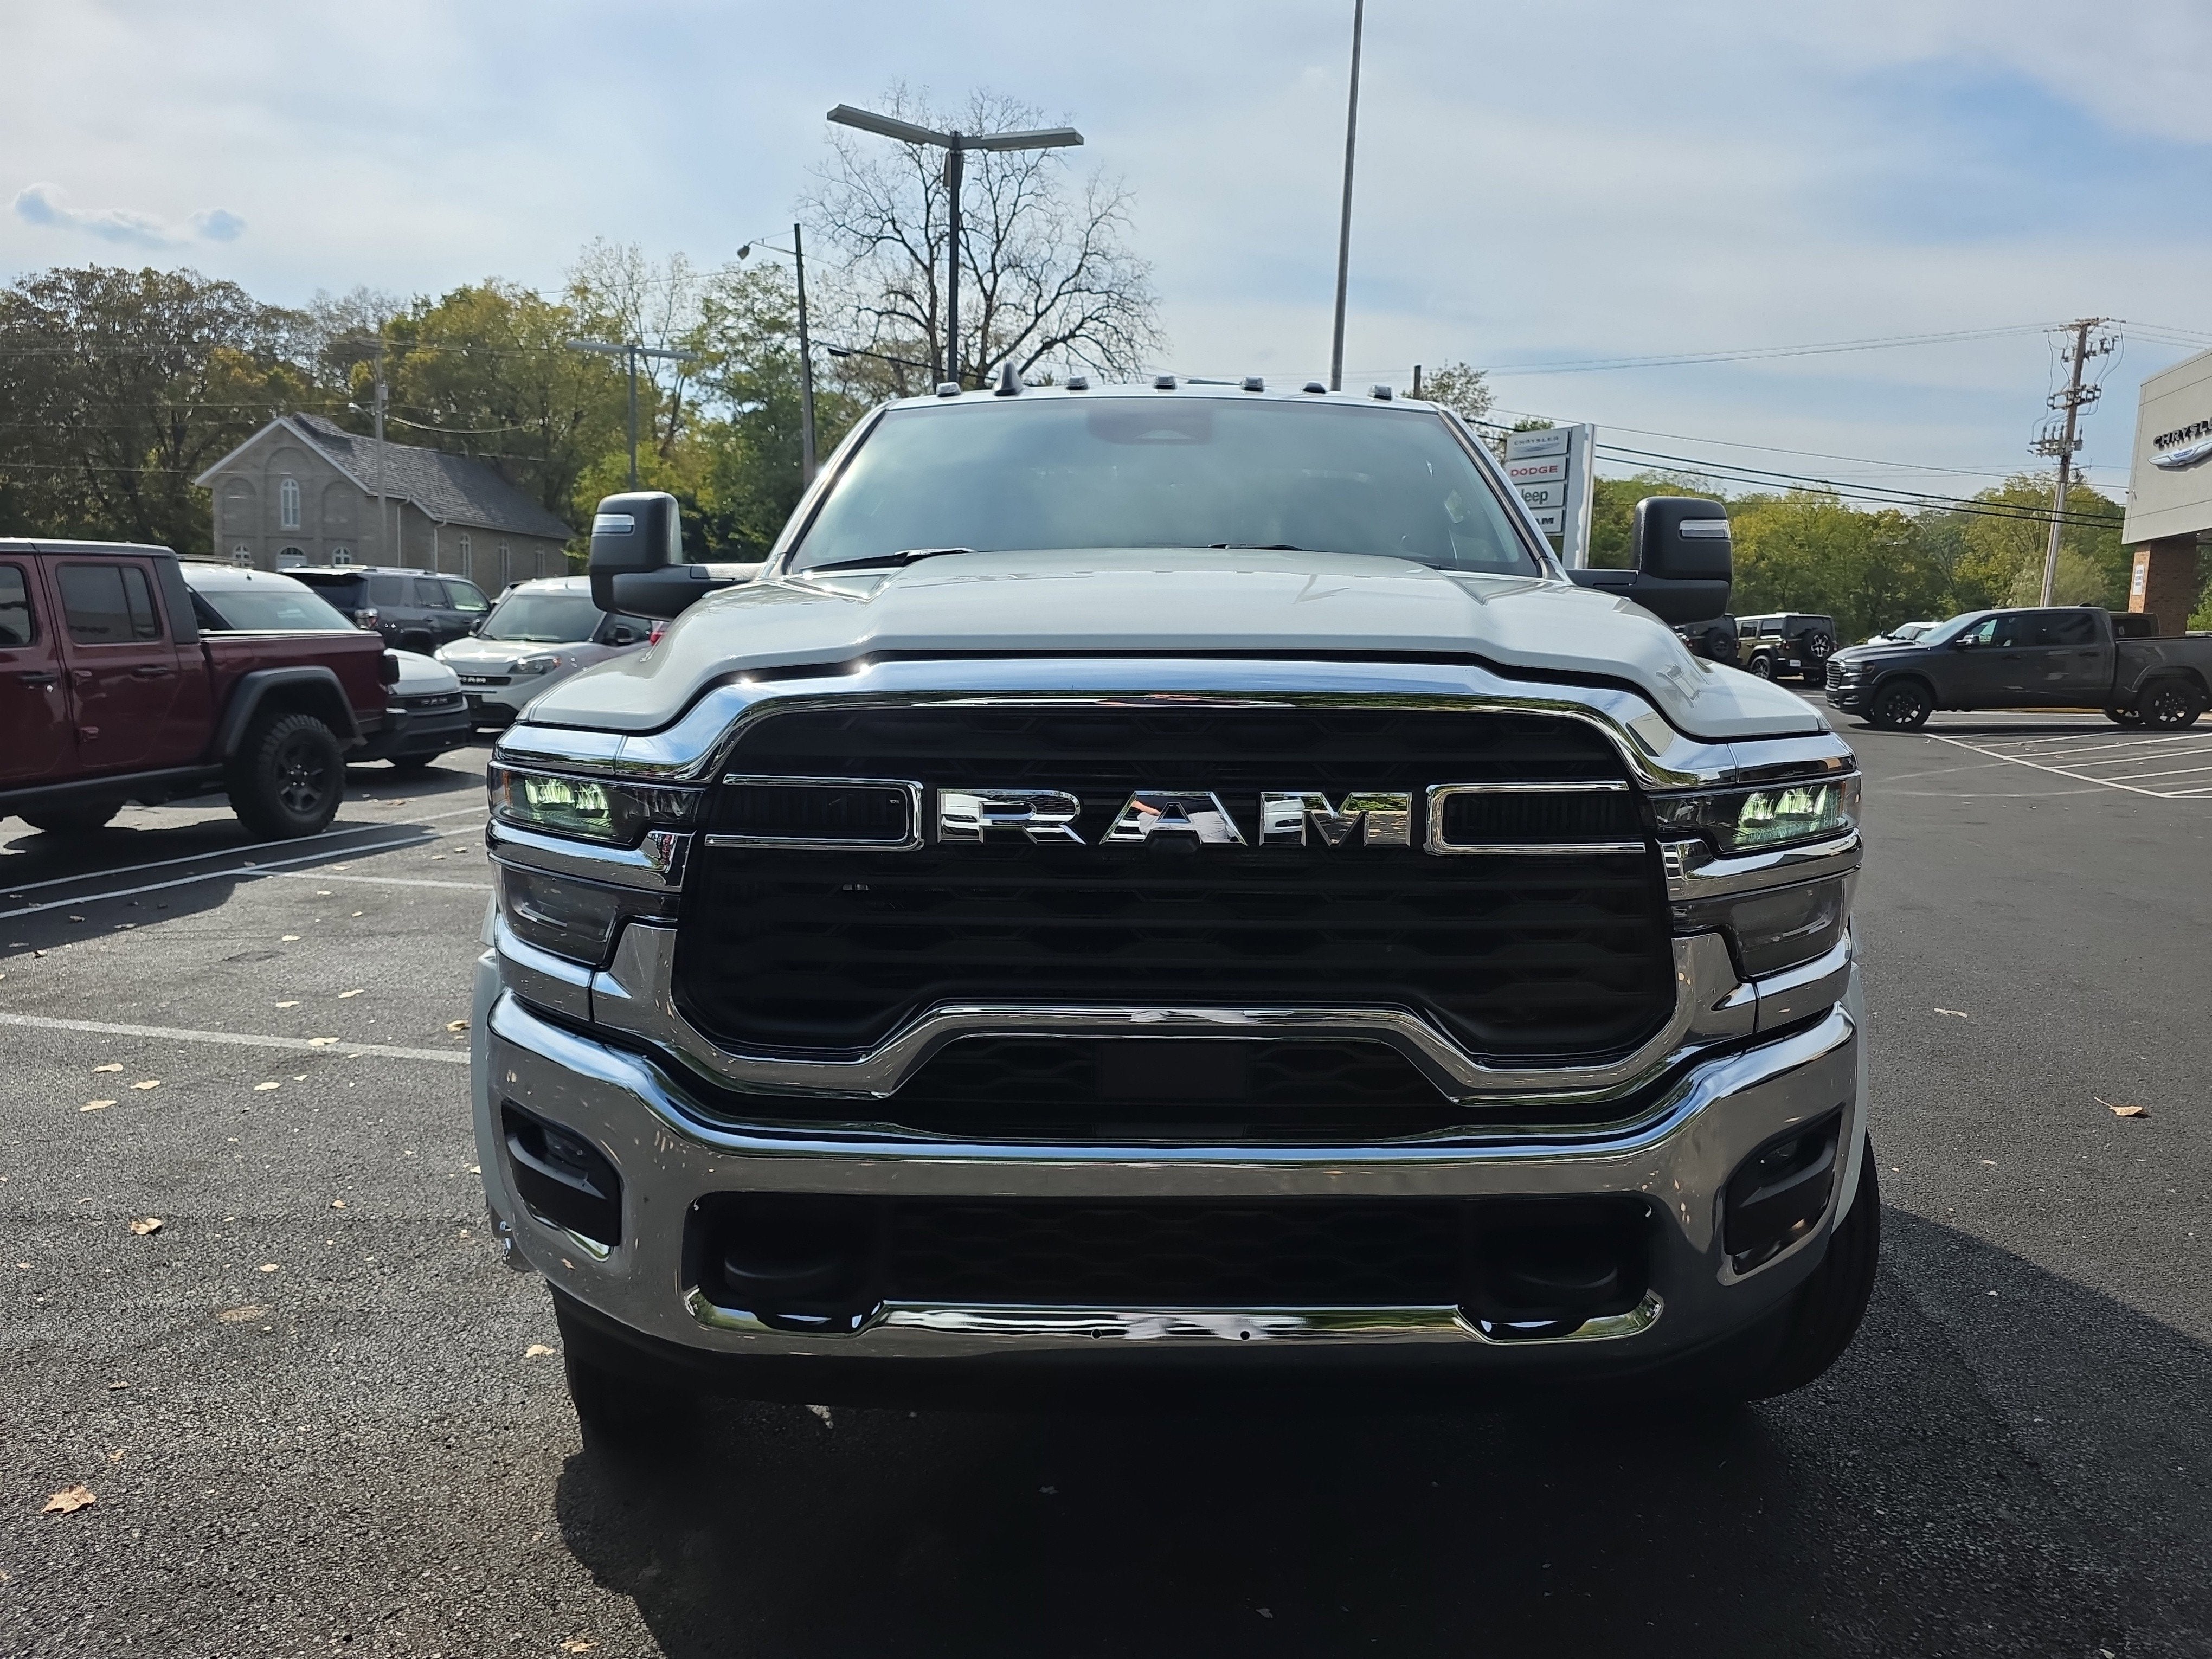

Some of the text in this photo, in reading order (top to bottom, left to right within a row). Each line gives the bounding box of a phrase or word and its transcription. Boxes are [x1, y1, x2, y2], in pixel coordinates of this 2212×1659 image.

[1514, 436, 1559, 445] CHRYSLER
[1511, 466, 1558, 476] DODGE
[937, 788, 1412, 846] RAM
